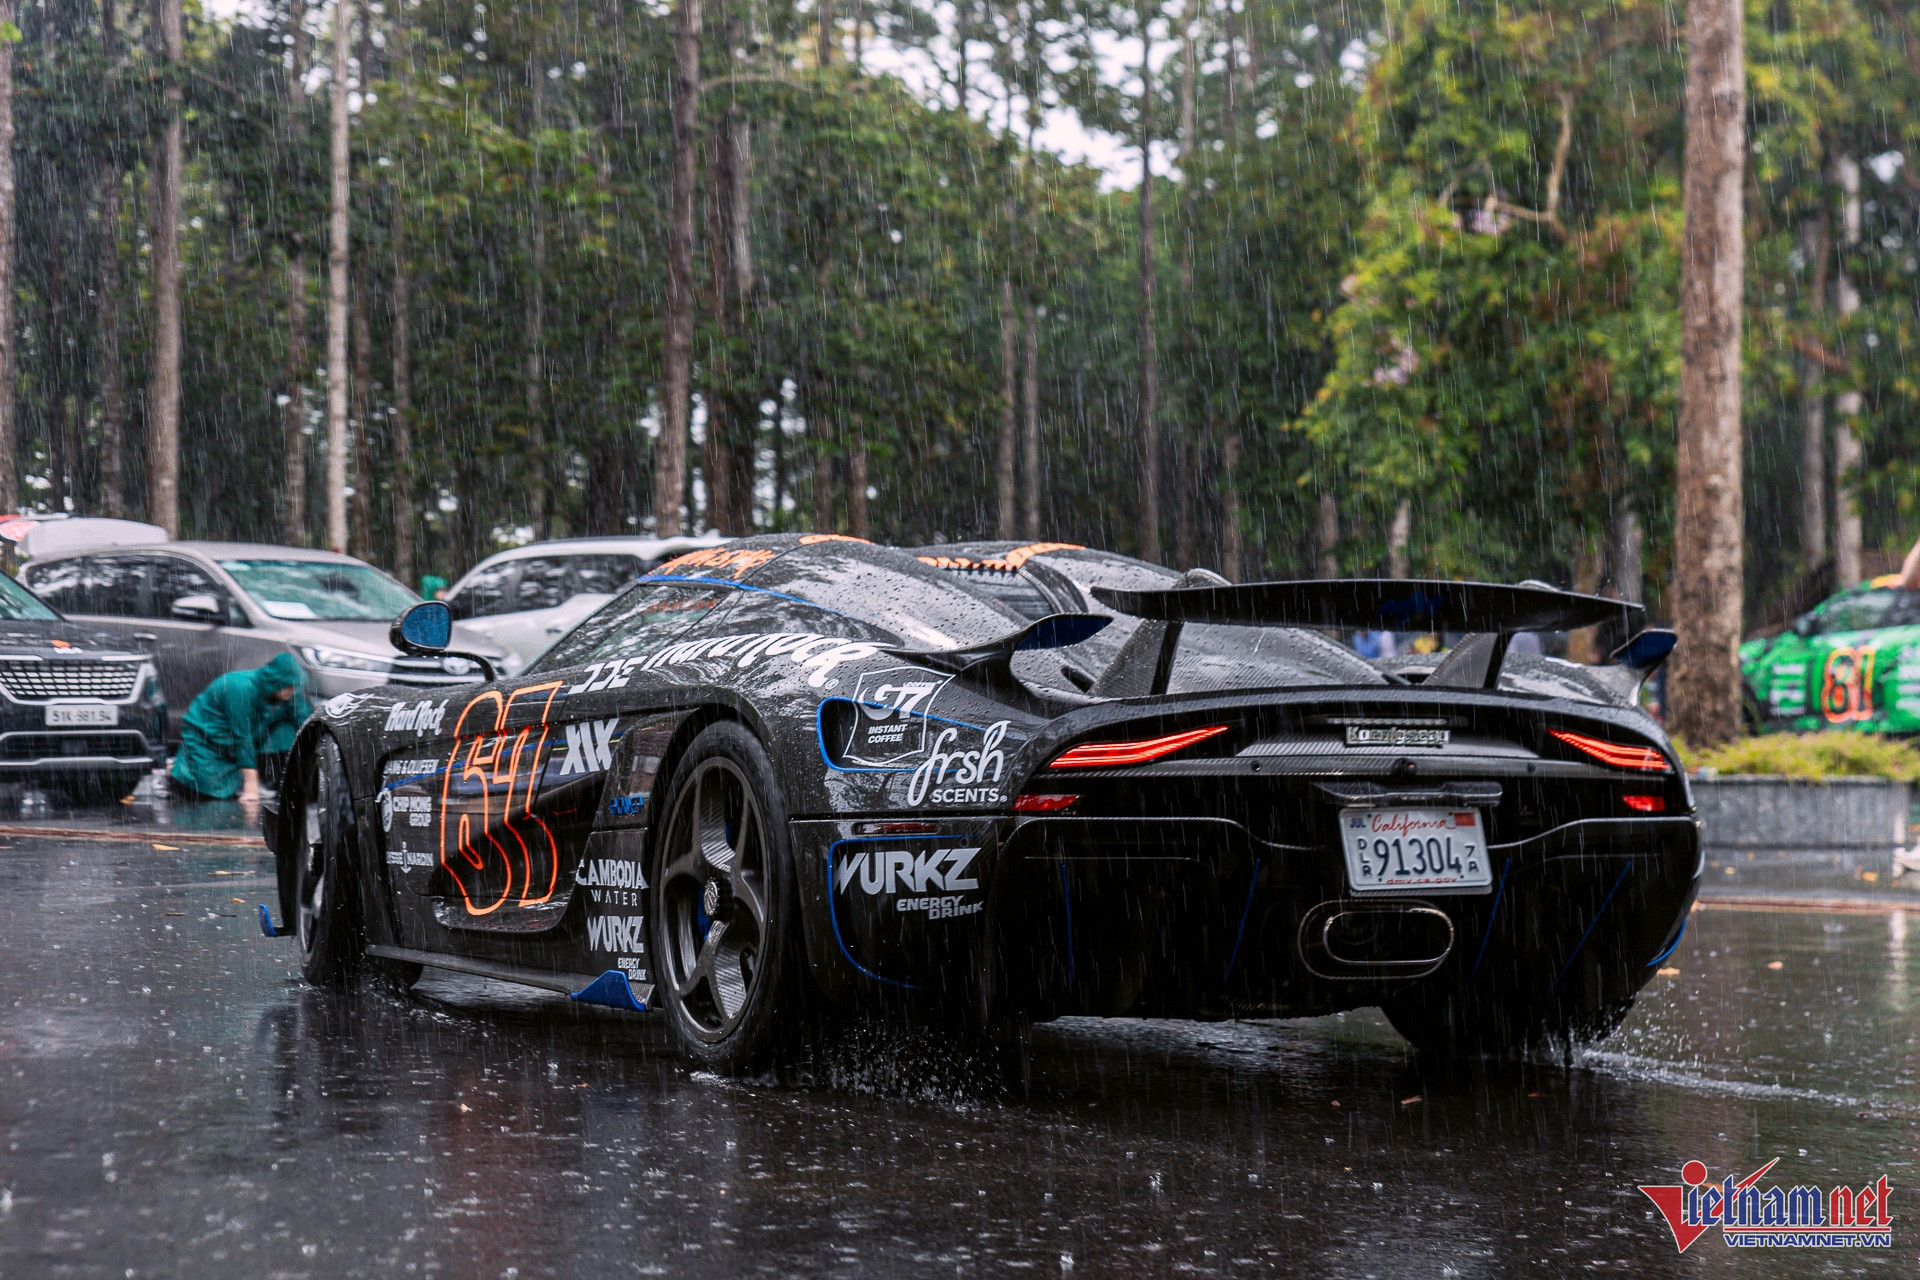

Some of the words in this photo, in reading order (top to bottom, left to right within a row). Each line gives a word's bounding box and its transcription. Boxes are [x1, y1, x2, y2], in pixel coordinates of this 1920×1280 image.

[384, 701, 425, 731] Hard
[414, 699, 449, 737] Rock
[868, 724, 908, 734] INSTANT
[868, 733, 904, 743] COFFEE
[1346, 727, 1450, 745] Koenigsegg
[908, 720, 1011, 806] frsh
[931, 787, 1000, 803] SCENTS
[1372, 813, 1456, 837] California
[1373, 837, 1462, 876] 91304
[575, 859, 649, 889] CAMBODIA
[834, 847, 981, 895] WURKZ
[591, 889, 637, 906] WATER
[896, 895, 964, 911] ENERGY
[929, 900, 984, 920] DRINK
[587, 915, 644, 953] WURKZ
[618, 957, 640, 969] ENERGY
[628, 969, 646, 980] DRINK
